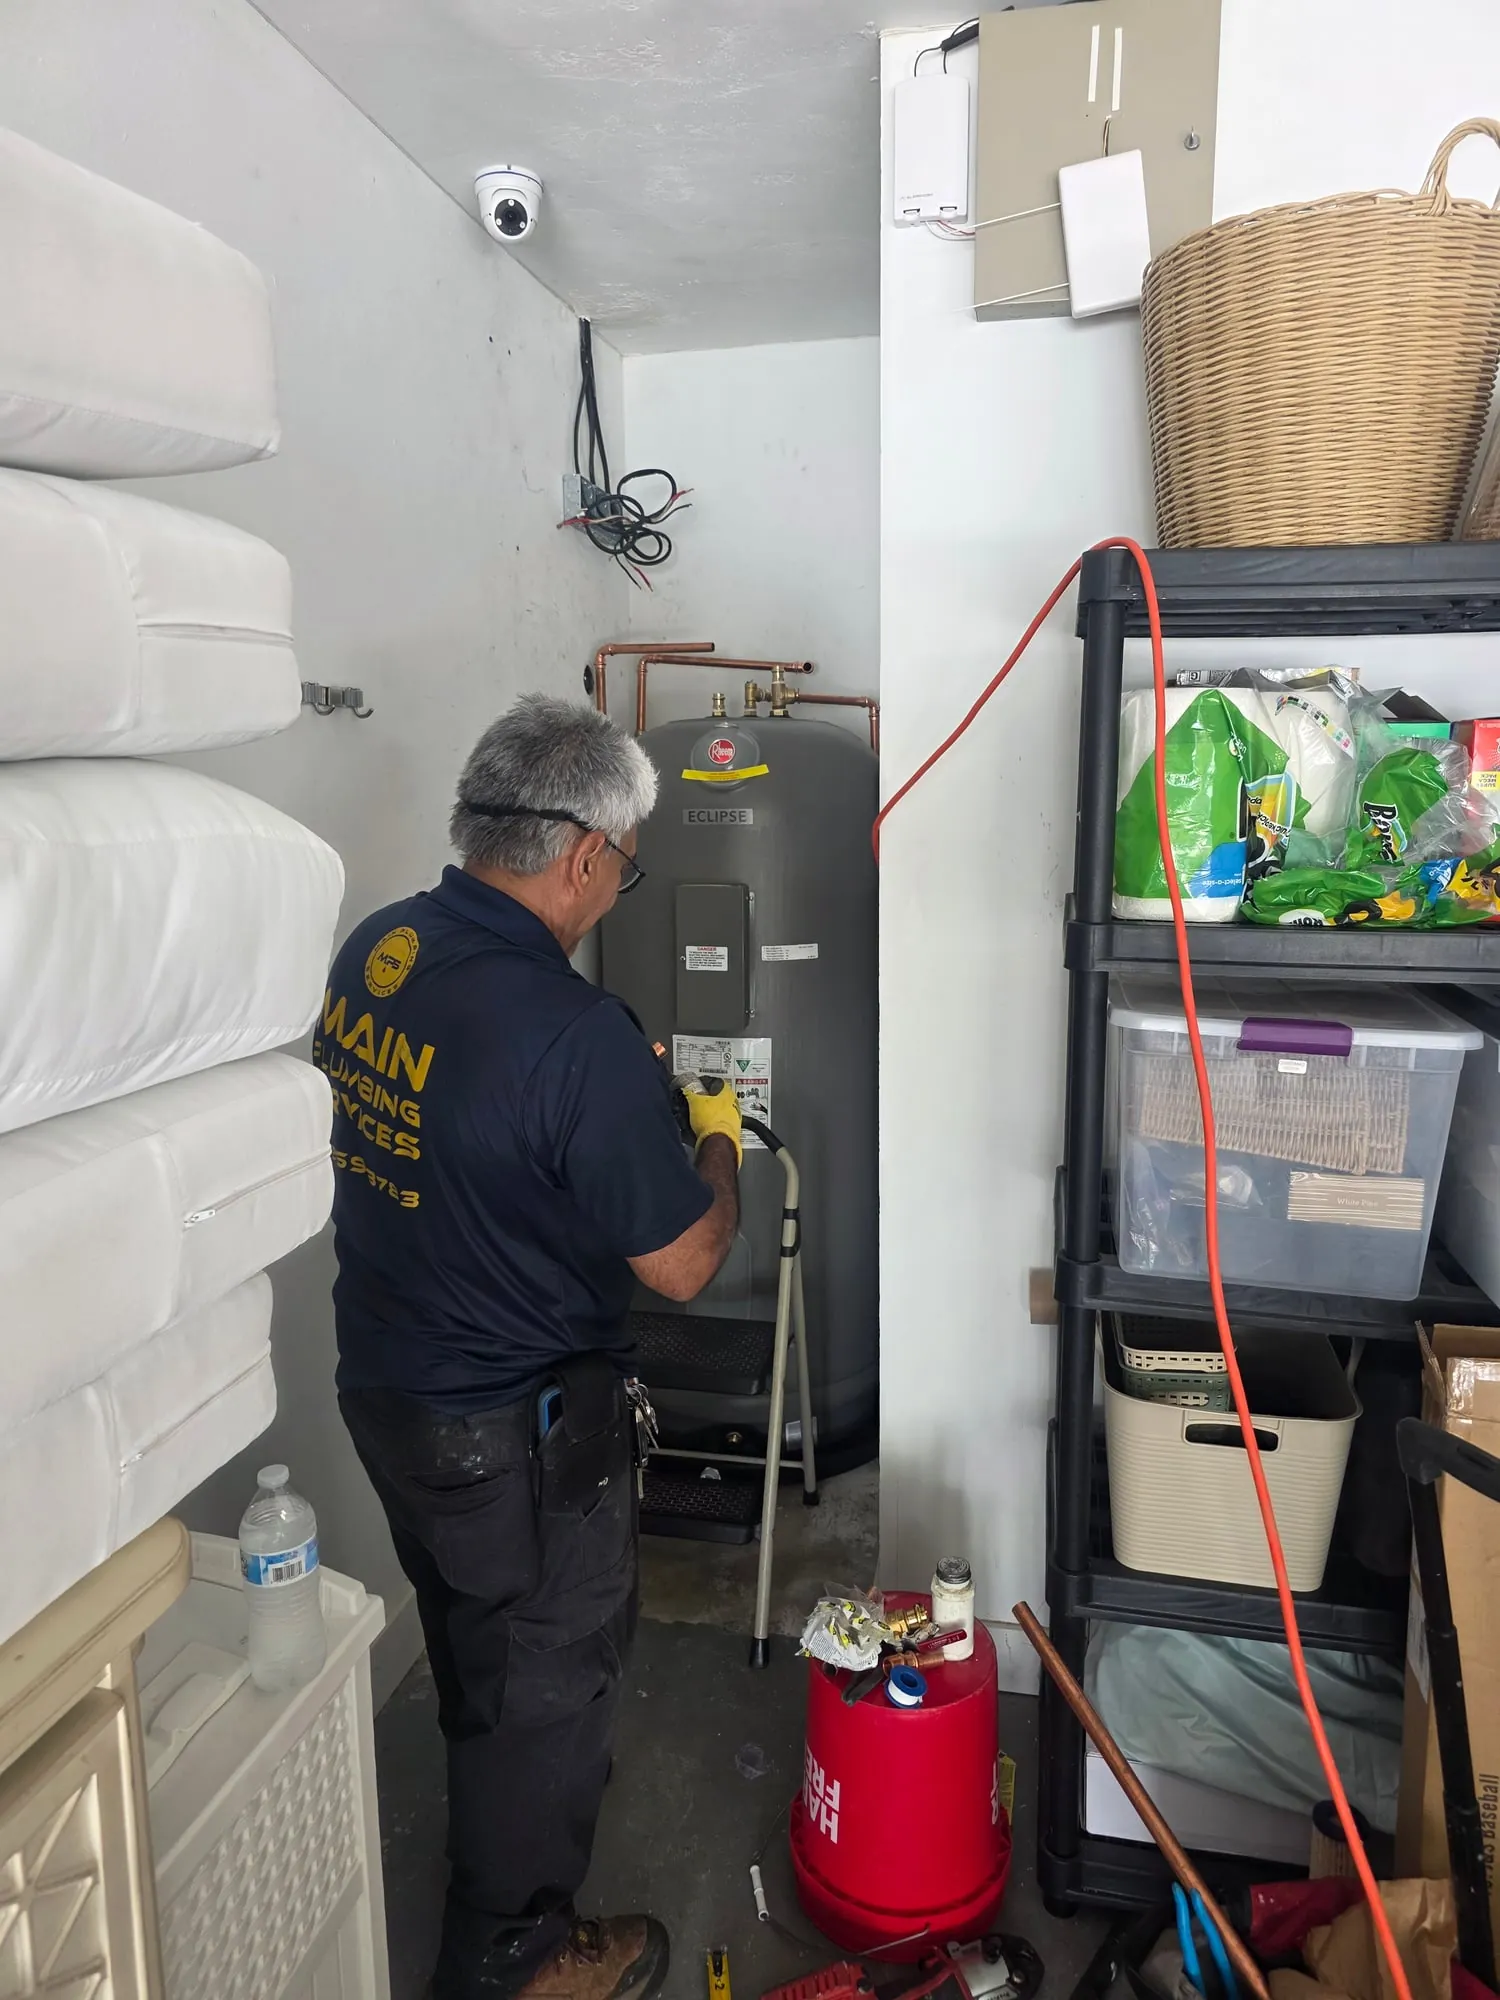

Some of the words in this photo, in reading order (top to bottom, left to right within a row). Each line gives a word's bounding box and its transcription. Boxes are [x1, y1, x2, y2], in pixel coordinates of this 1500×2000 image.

[711, 741, 733, 760] Rheem
[688, 809, 748, 824] ECLIPSE
[377, 952, 402, 970] MPS
[322, 986, 436, 1092] MAIN
[332, 1087, 421, 1161] RVICES
[1479, 1773, 1500, 1839] Baseball
